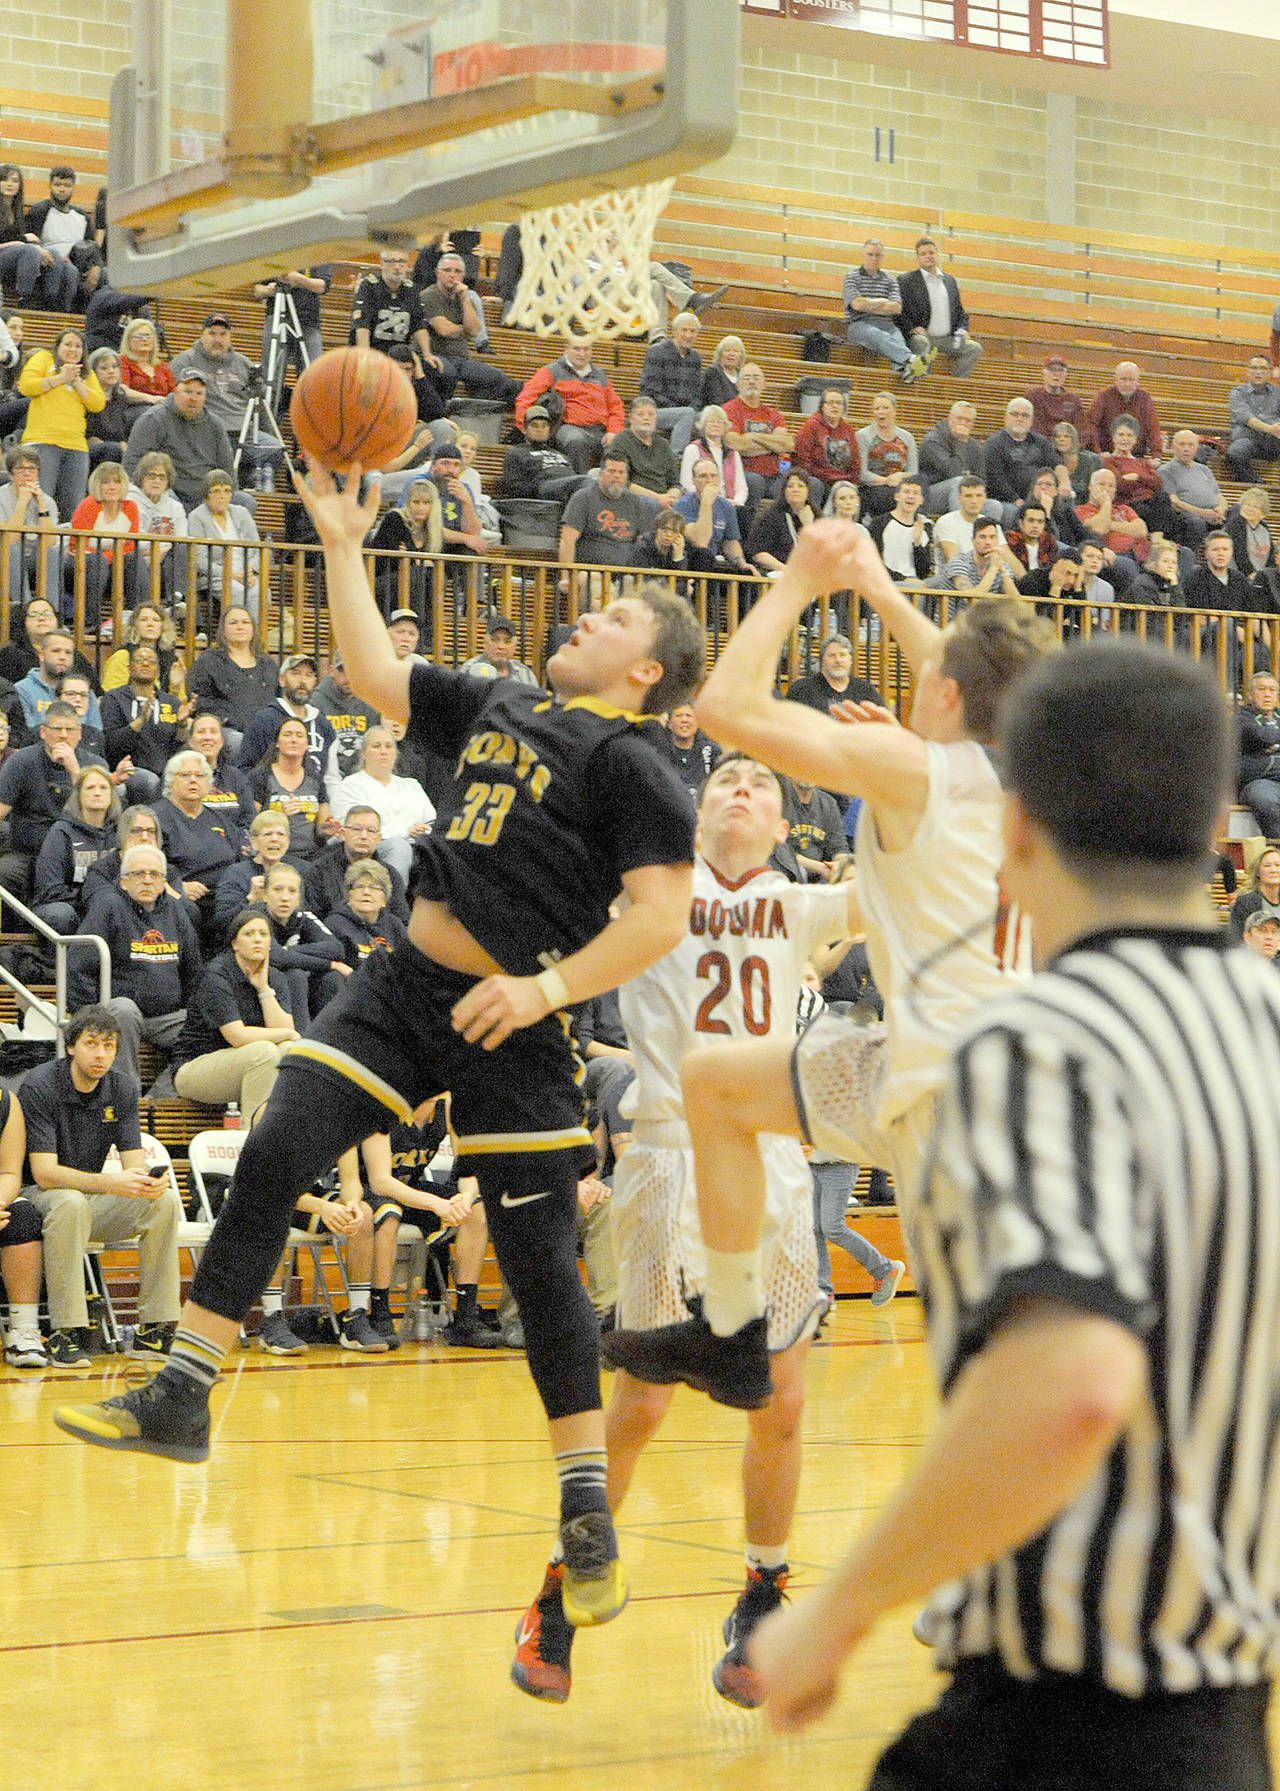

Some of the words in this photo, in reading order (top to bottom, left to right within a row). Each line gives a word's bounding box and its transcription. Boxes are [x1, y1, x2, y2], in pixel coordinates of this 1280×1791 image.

[445, 782, 517, 846] 33
[690, 897, 788, 940] OQUIAM
[696, 951, 771, 1036] 20
